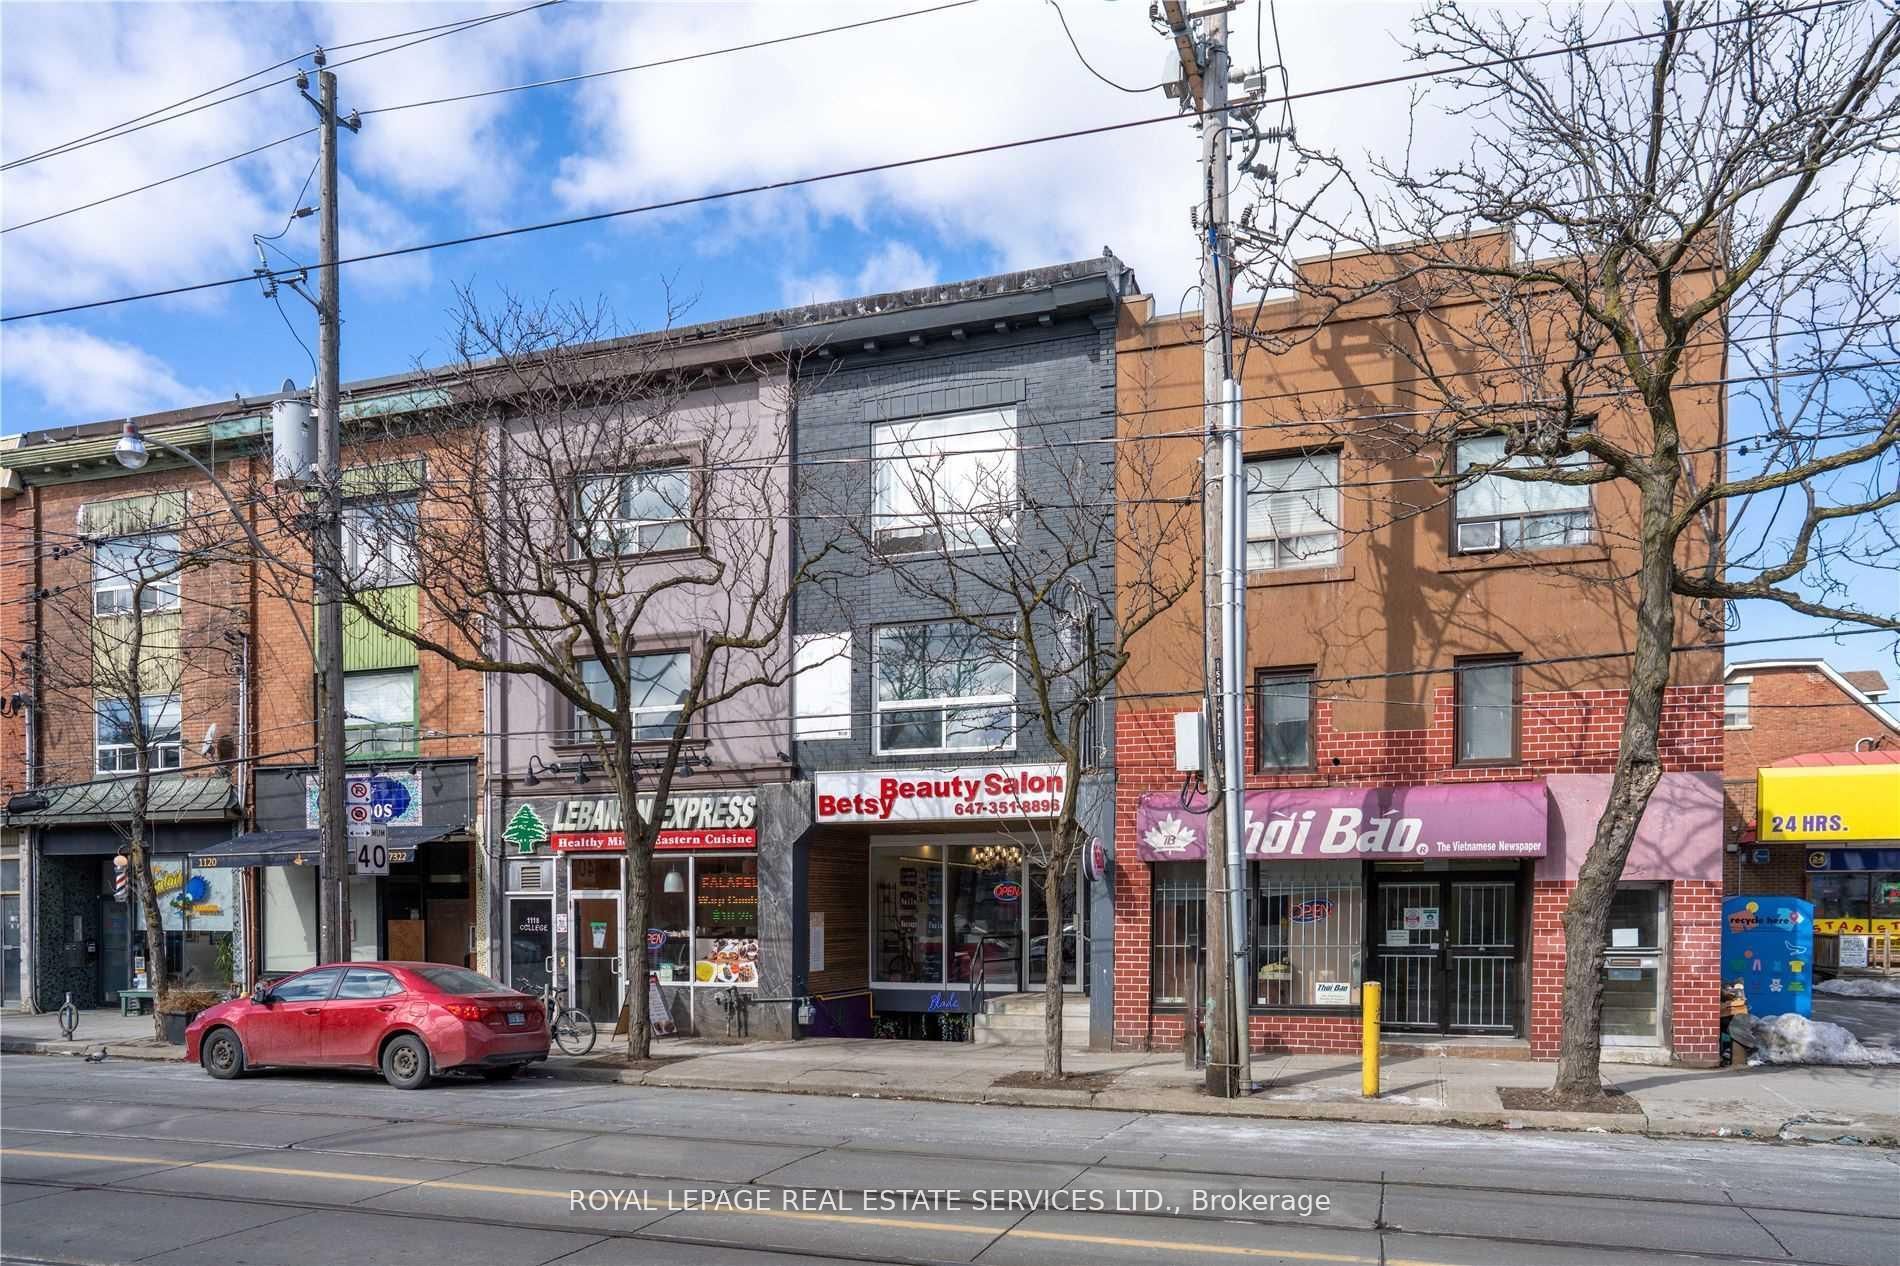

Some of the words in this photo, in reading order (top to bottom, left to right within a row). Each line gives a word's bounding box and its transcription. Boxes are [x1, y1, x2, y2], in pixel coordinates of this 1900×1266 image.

[818, 795, 895, 819] Betsy
[880, 776, 981, 801] Beauty
[984, 771, 1064, 796] Salon
[553, 800, 655, 831] LEBANN
[660, 796, 757, 829] EXPRESS
[1772, 816, 1797, 832] 24
[1802, 815, 1849, 832] HRS.
[1245, 810, 1316, 855] hời
[558, 838, 605, 849] Healthy
[705, 834, 753, 844] Cuisine
[1437, 841, 1451, 852] The
[1451, 841, 1497, 852] Vietnamese
[1499, 841, 1542, 853] Newspaper
[199, 858, 217, 867] 1120
[358, 844, 387, 868] 40
[996, 886, 1021, 897] OPEN
[519, 924, 549, 932] COLLEGE
[1730, 915, 1763, 926] recycle
[1767, 915, 1790, 925] here
